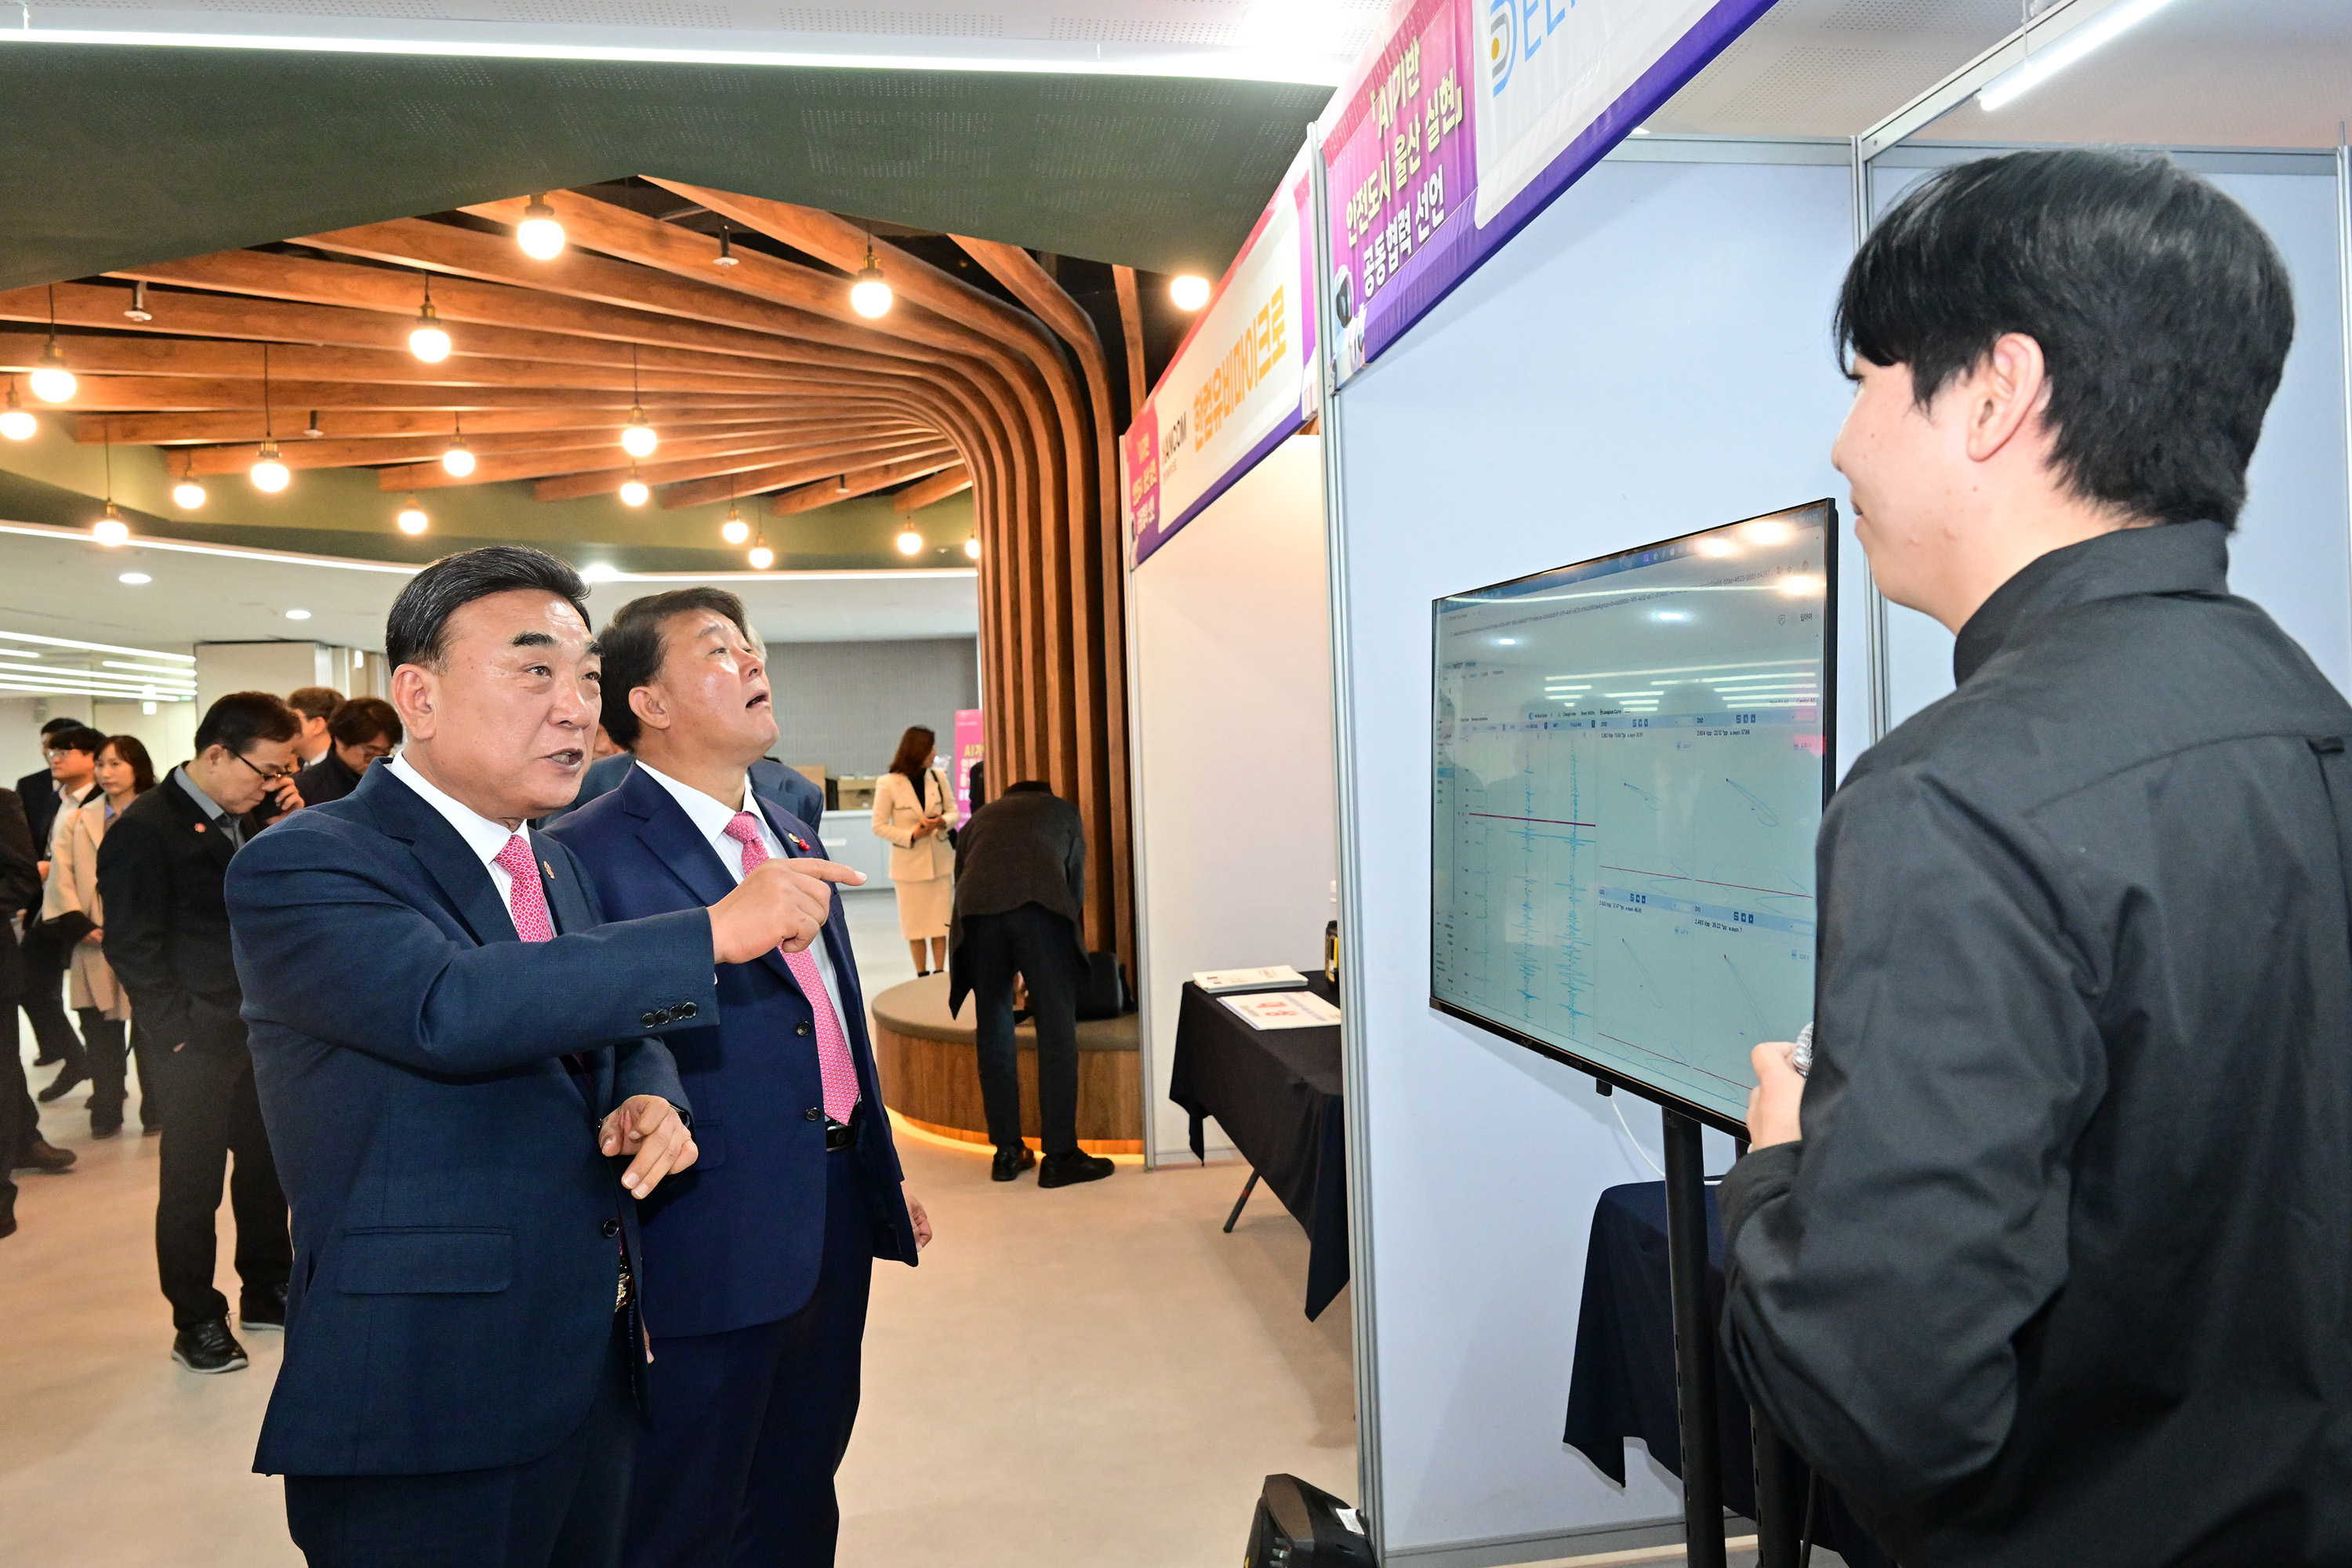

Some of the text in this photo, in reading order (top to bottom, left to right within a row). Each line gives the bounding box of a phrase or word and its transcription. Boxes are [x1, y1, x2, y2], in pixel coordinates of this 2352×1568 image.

[1346, 151, 1391, 249] 안전도시
[1395, 113, 1421, 191] 울산
[1363, 164, 1444, 297] 공동협력 선언
[1193, 284, 1287, 453] 한컴유비마이크로
